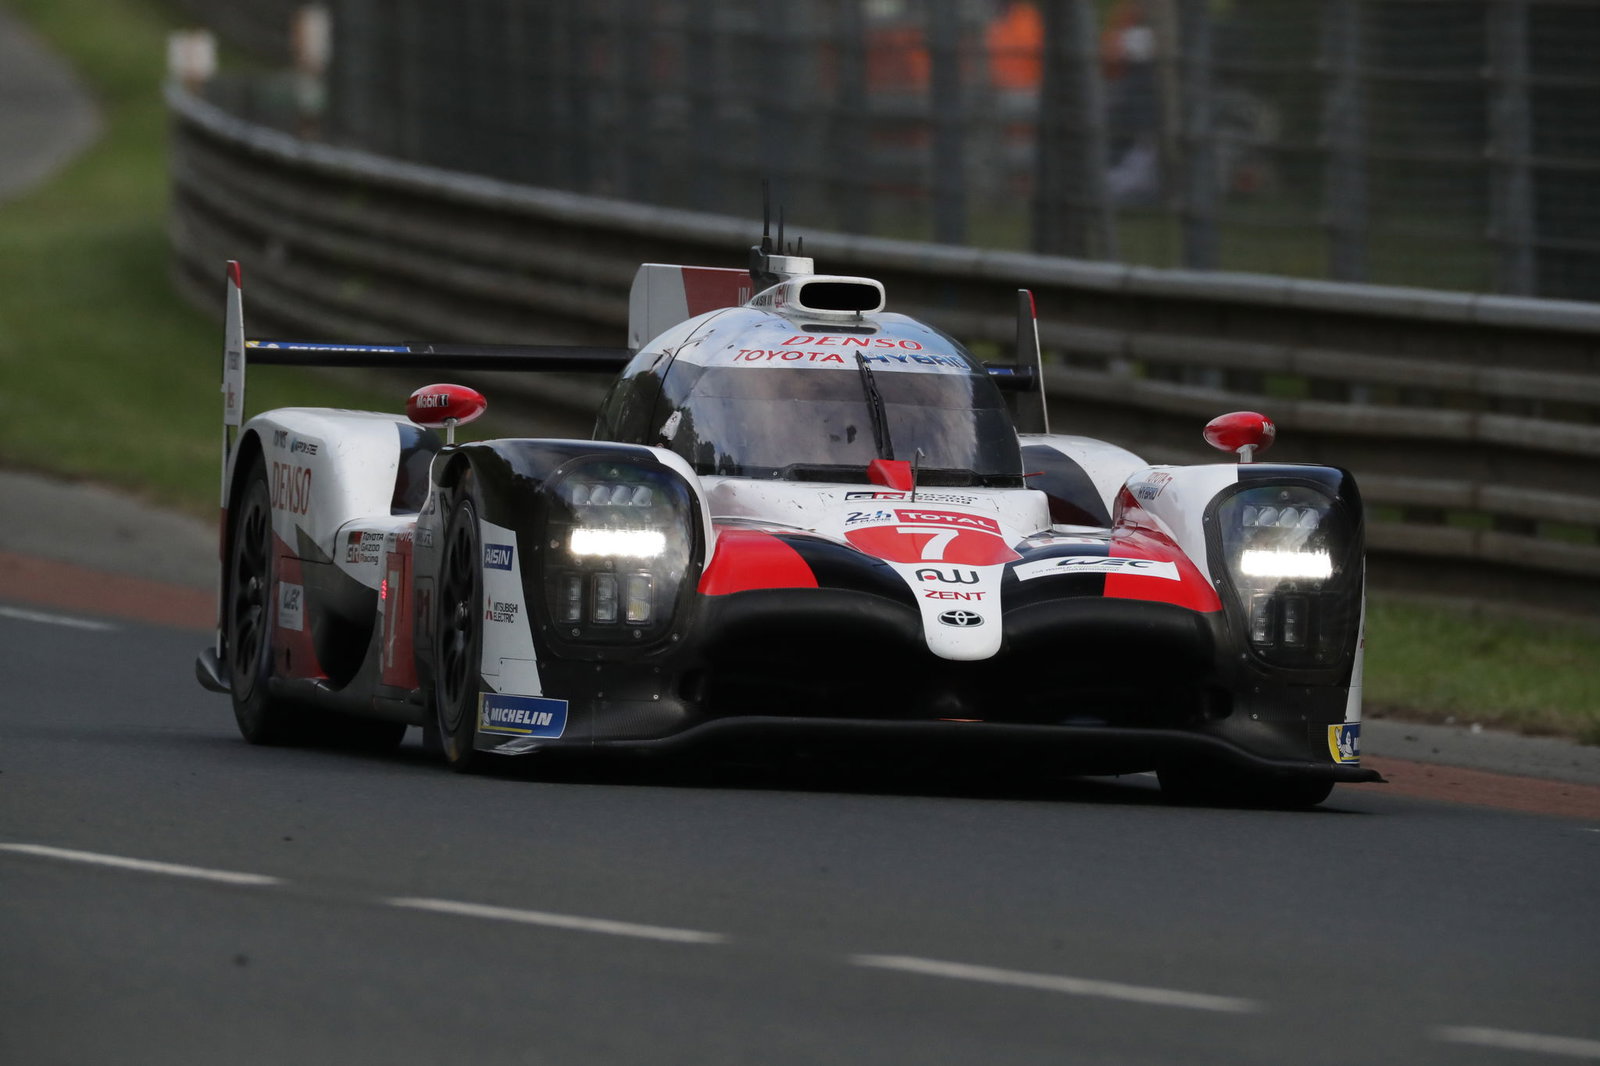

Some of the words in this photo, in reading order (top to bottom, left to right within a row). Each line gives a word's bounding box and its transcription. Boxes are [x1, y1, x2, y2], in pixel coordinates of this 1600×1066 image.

[780, 335, 924, 351] DENSO
[732, 349, 845, 364] TOYOTA
[863, 353, 972, 371] HYBRID
[416, 393, 438, 409] Mobil
[271, 461, 312, 515] DENSO
[900, 512, 997, 530] TOTAL
[896, 526, 960, 560] 7
[485, 548, 511, 566] AISIN
[1057, 557, 1155, 569] WEC
[924, 588, 987, 601] ZENT
[490, 707, 553, 726] MICHELIN
